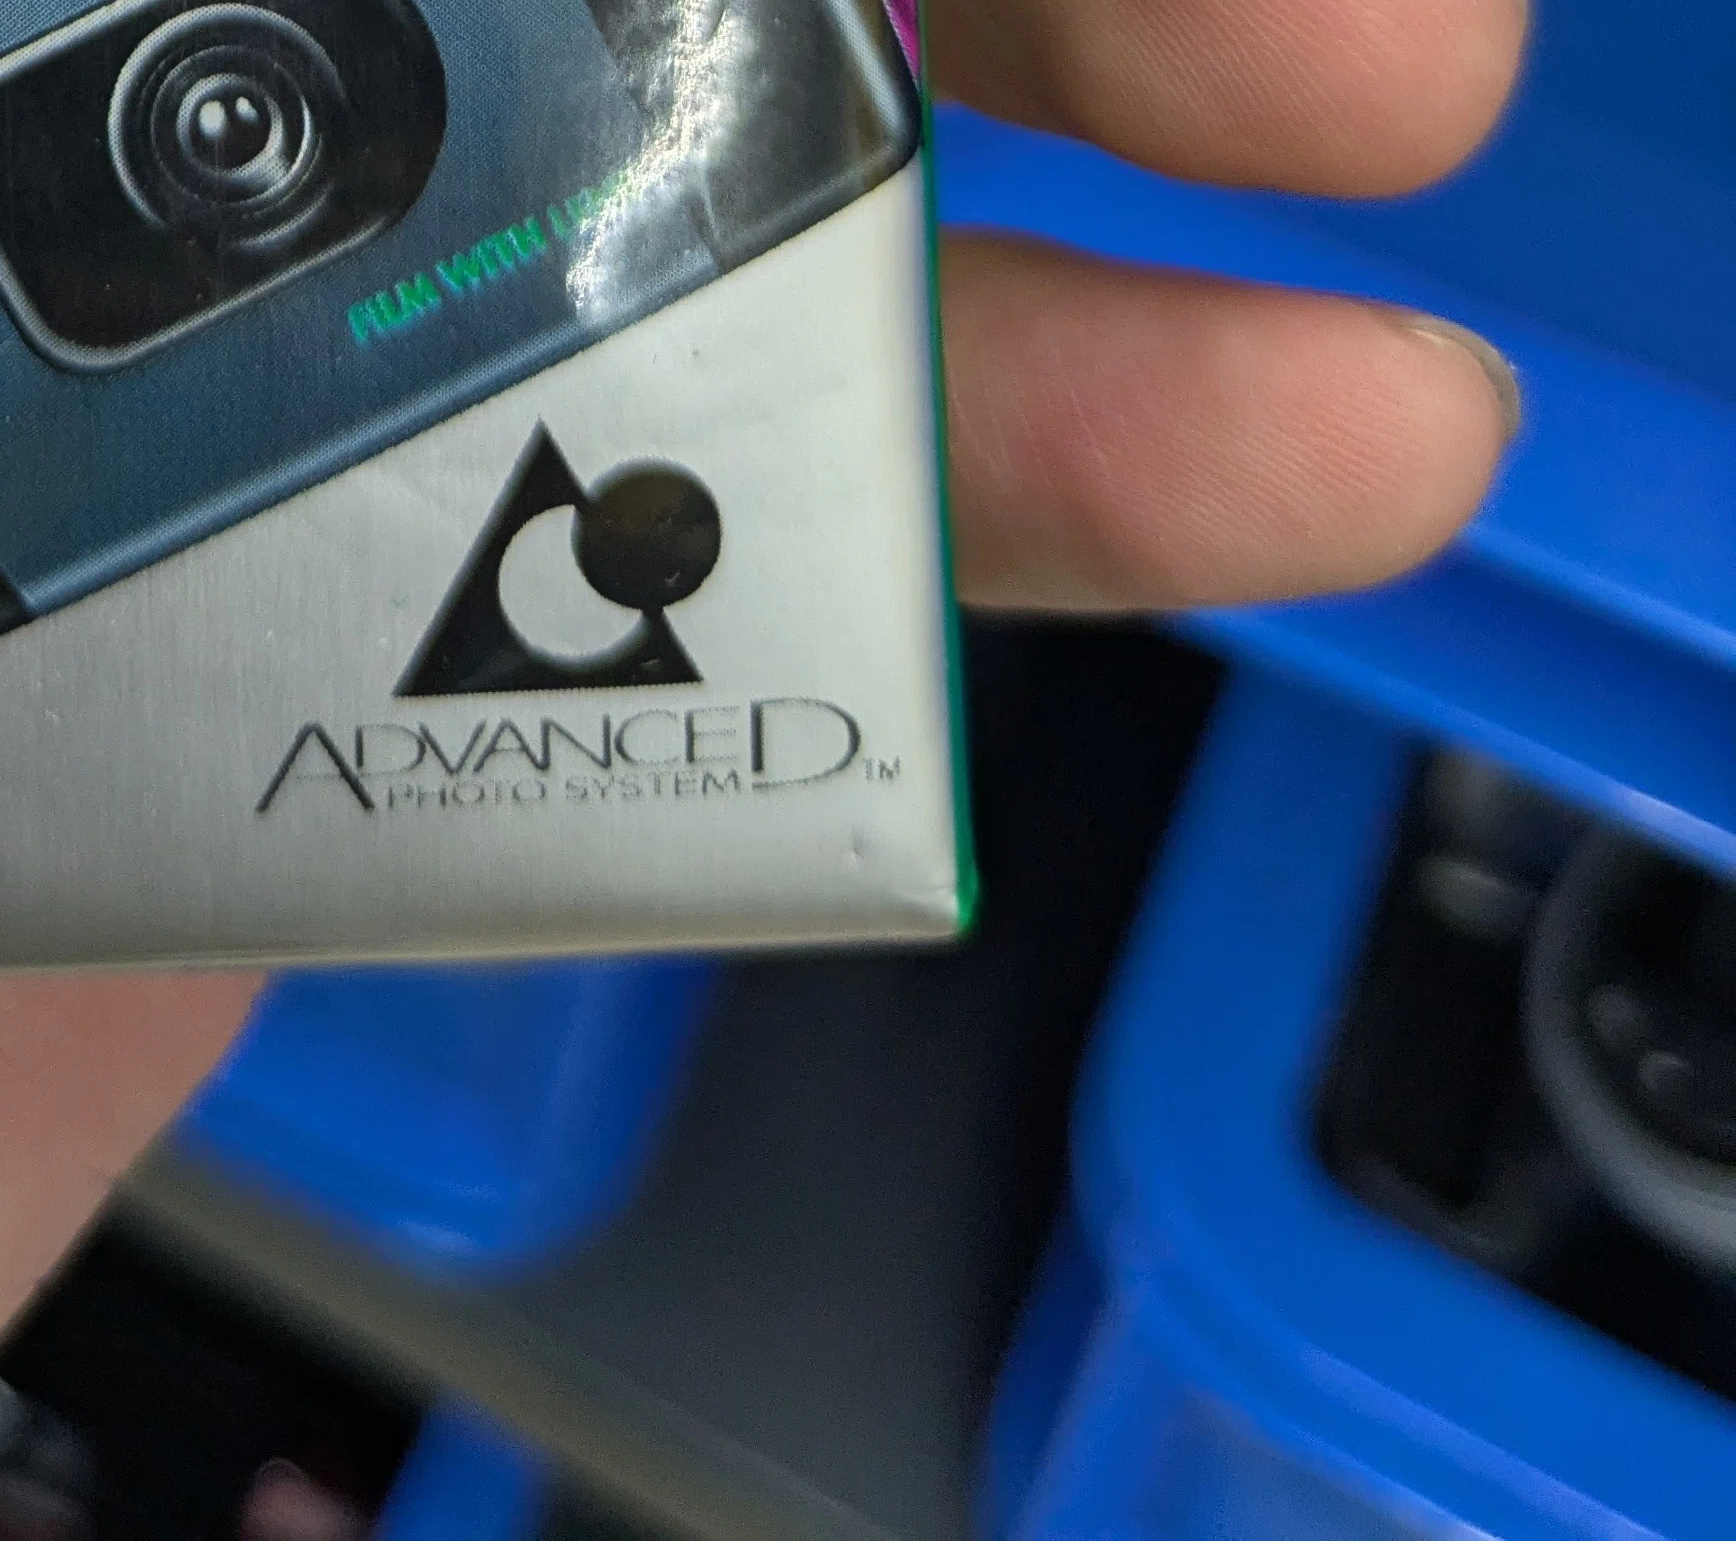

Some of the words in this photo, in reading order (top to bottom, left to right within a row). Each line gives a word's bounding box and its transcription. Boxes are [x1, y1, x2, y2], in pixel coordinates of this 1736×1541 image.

[436, 216, 548, 294] WITH
[255, 697, 861, 813] ADVANCED
[387, 775, 547, 809] PHOTO
[564, 768, 741, 803] SYSTEM
